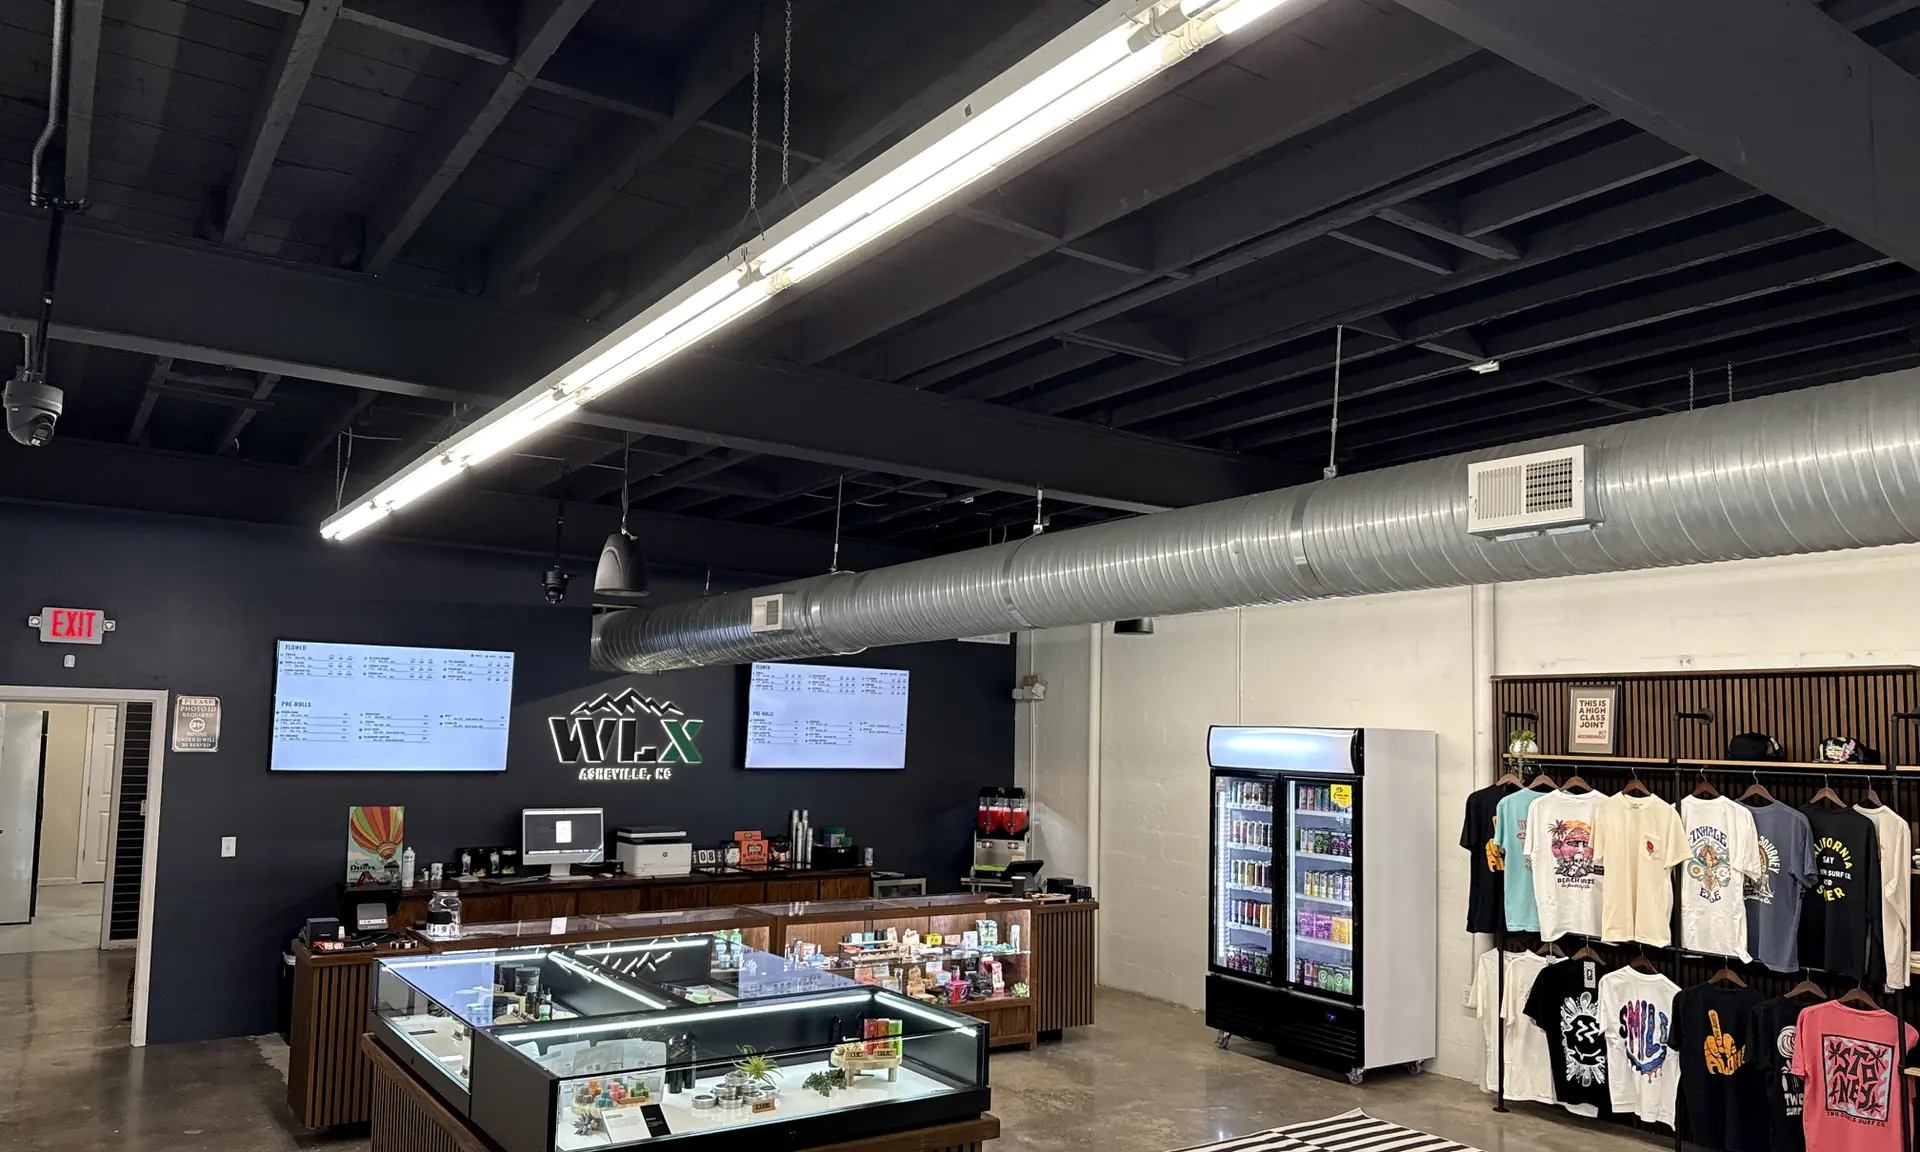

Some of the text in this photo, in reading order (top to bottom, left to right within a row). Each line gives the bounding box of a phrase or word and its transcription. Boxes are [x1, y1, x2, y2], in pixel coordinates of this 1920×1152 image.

[51, 609, 96, 640] EXIT
[549, 716, 704, 764] WLX
[578, 767, 672, 781] ASHEVILLE, NC
[1689, 825, 1728, 848] INHALE
[1813, 836, 1853, 870] ALIFORNIA
[1822, 855, 1835, 864] SAY
[1827, 870, 1845, 878] SURF
